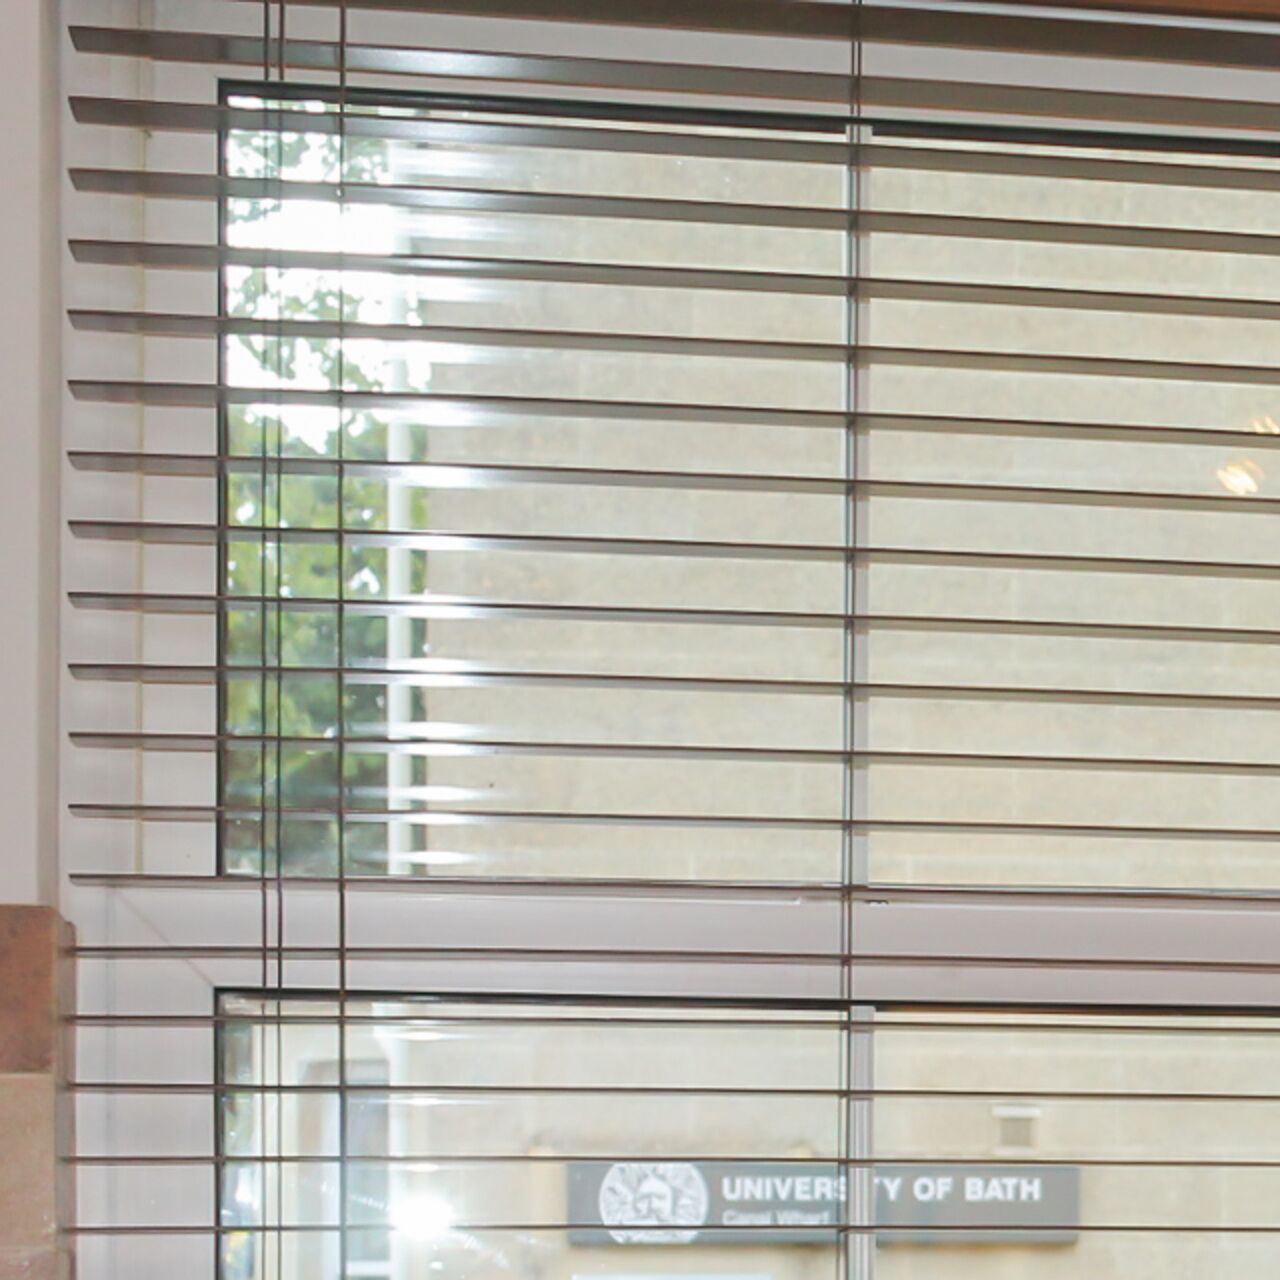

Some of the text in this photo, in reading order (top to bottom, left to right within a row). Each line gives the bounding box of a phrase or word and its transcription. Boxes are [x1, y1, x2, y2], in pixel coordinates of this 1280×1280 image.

[721, 1175, 1042, 1202] UNIVERSY OF BATH
